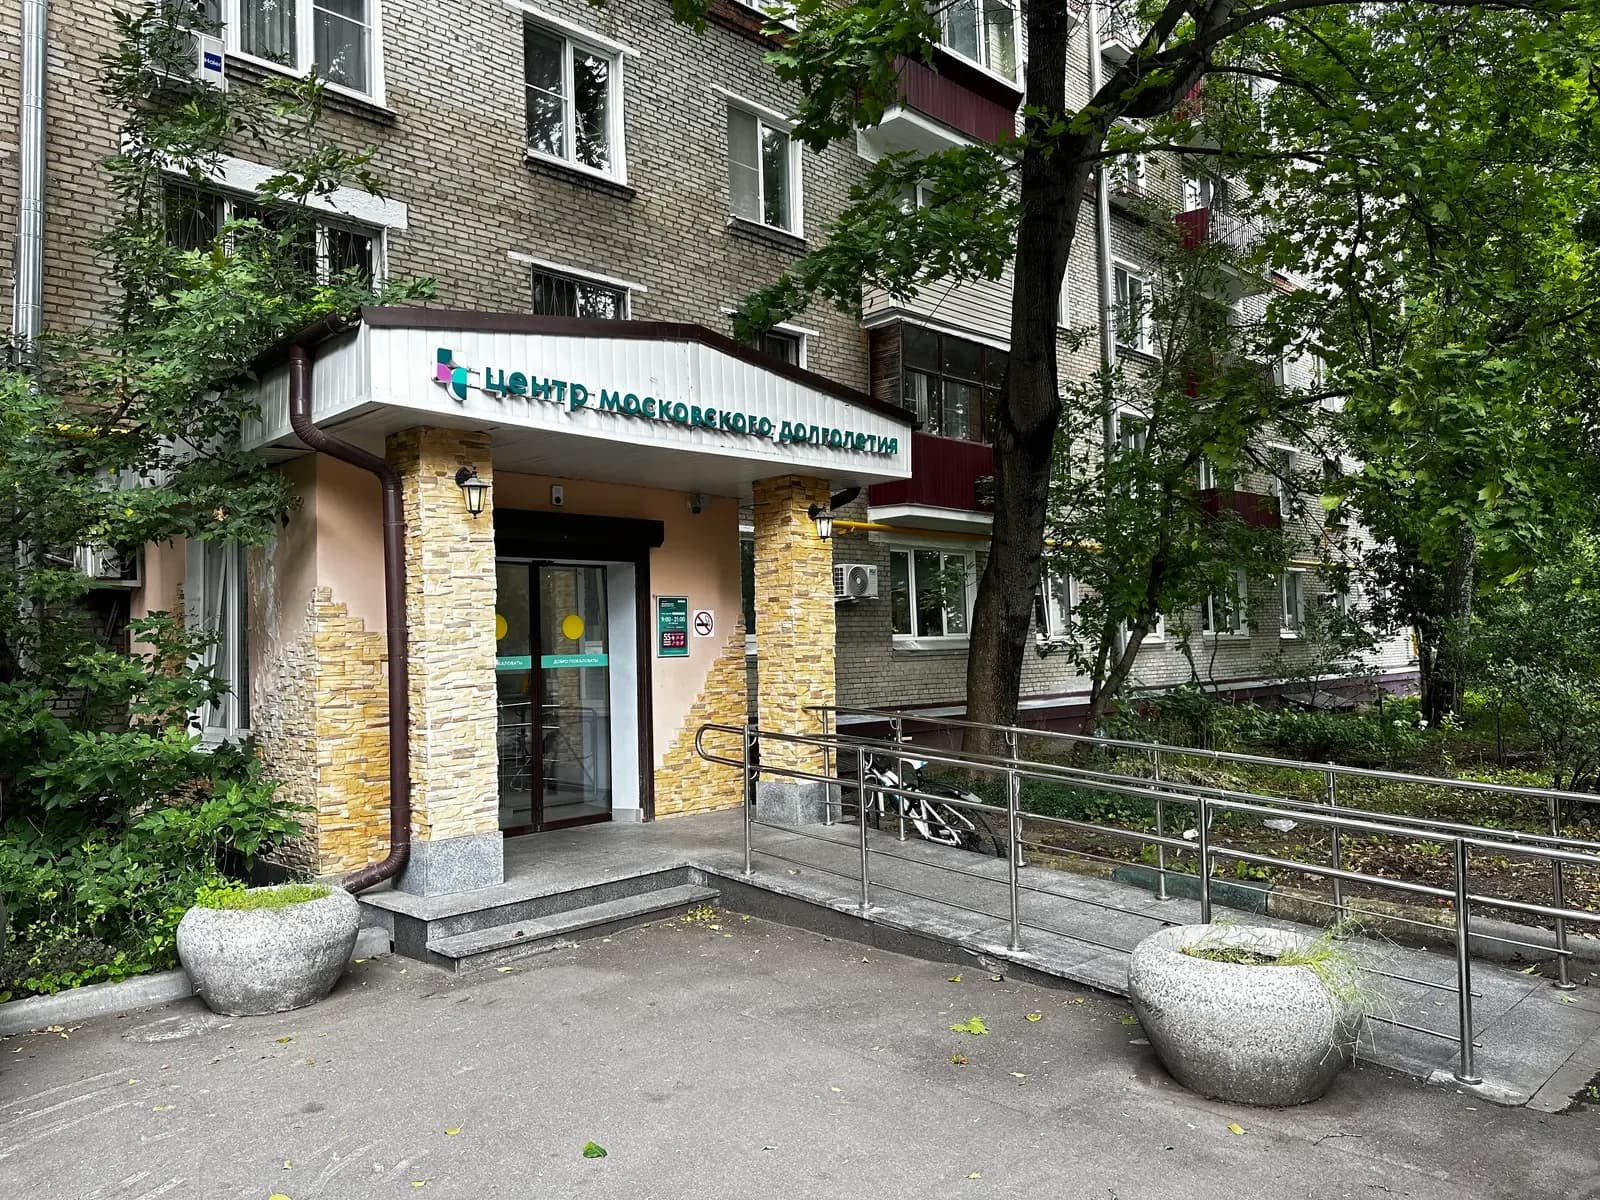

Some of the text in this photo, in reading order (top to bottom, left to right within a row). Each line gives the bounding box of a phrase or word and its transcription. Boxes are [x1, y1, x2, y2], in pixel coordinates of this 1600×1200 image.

[486, 367, 898, 454] центр московского долголетия
